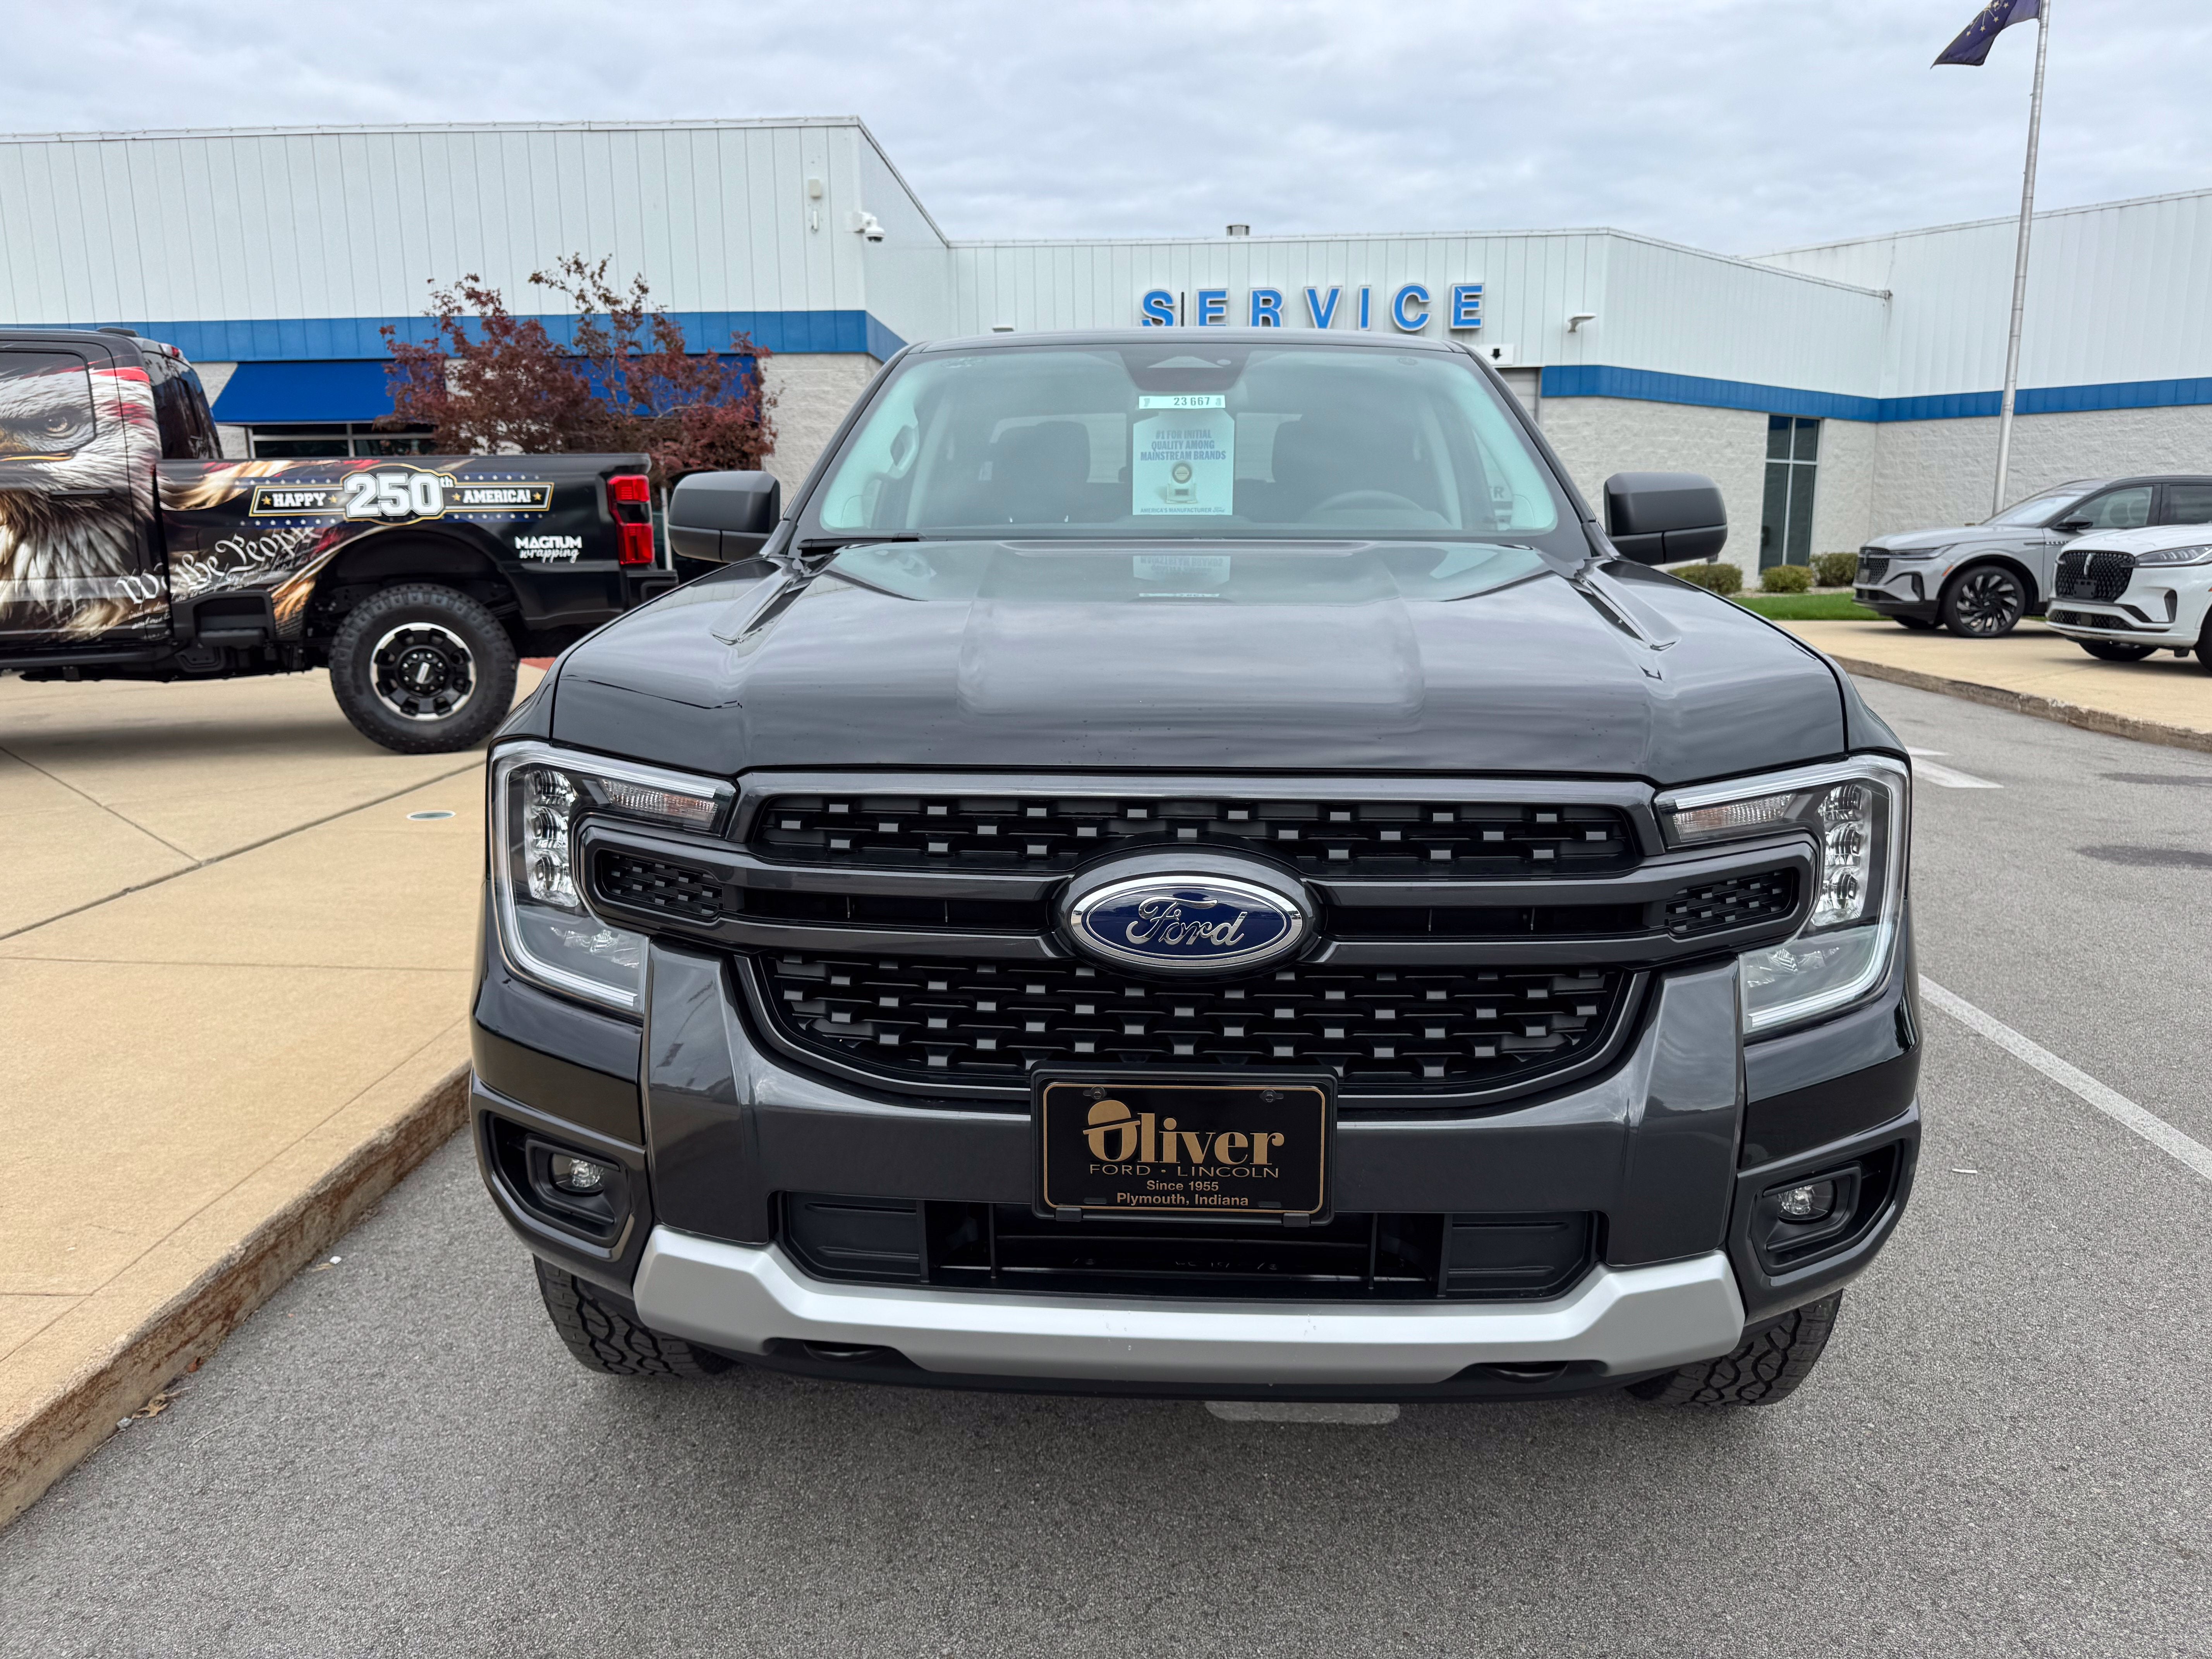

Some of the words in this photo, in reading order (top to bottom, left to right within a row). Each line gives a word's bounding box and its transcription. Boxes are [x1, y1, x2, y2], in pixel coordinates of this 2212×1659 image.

[1139, 283, 1485, 331] SERVICE
[1167, 430, 1182, 439] FOR
[1184, 429, 1212, 439] INITIAL
[1151, 441, 1184, 452] QUALITY
[1185, 440, 1215, 450] AMONG
[1140, 451, 1192, 461] MAINSTREAM
[1193, 450, 1226, 460] BRANDS
[272, 492, 326, 507] HAPPY
[463, 489, 531, 503] AMERICA!
[514, 535, 582, 549] MAGNUM
[519, 548, 580, 564] wrapping
[1126, 896, 1248, 946] Ford
[1082, 1099, 1285, 1166] Oliver
[1089, 1164, 1151, 1176] FORD
[1177, 1165, 1279, 1178] LINCOLN
[1146, 1180, 1184, 1191] Since
[1188, 1180, 1219, 1192] 1955
[1116, 1192, 1190, 1206] Plymouth,
[1195, 1193, 1249, 1206] Indiana
